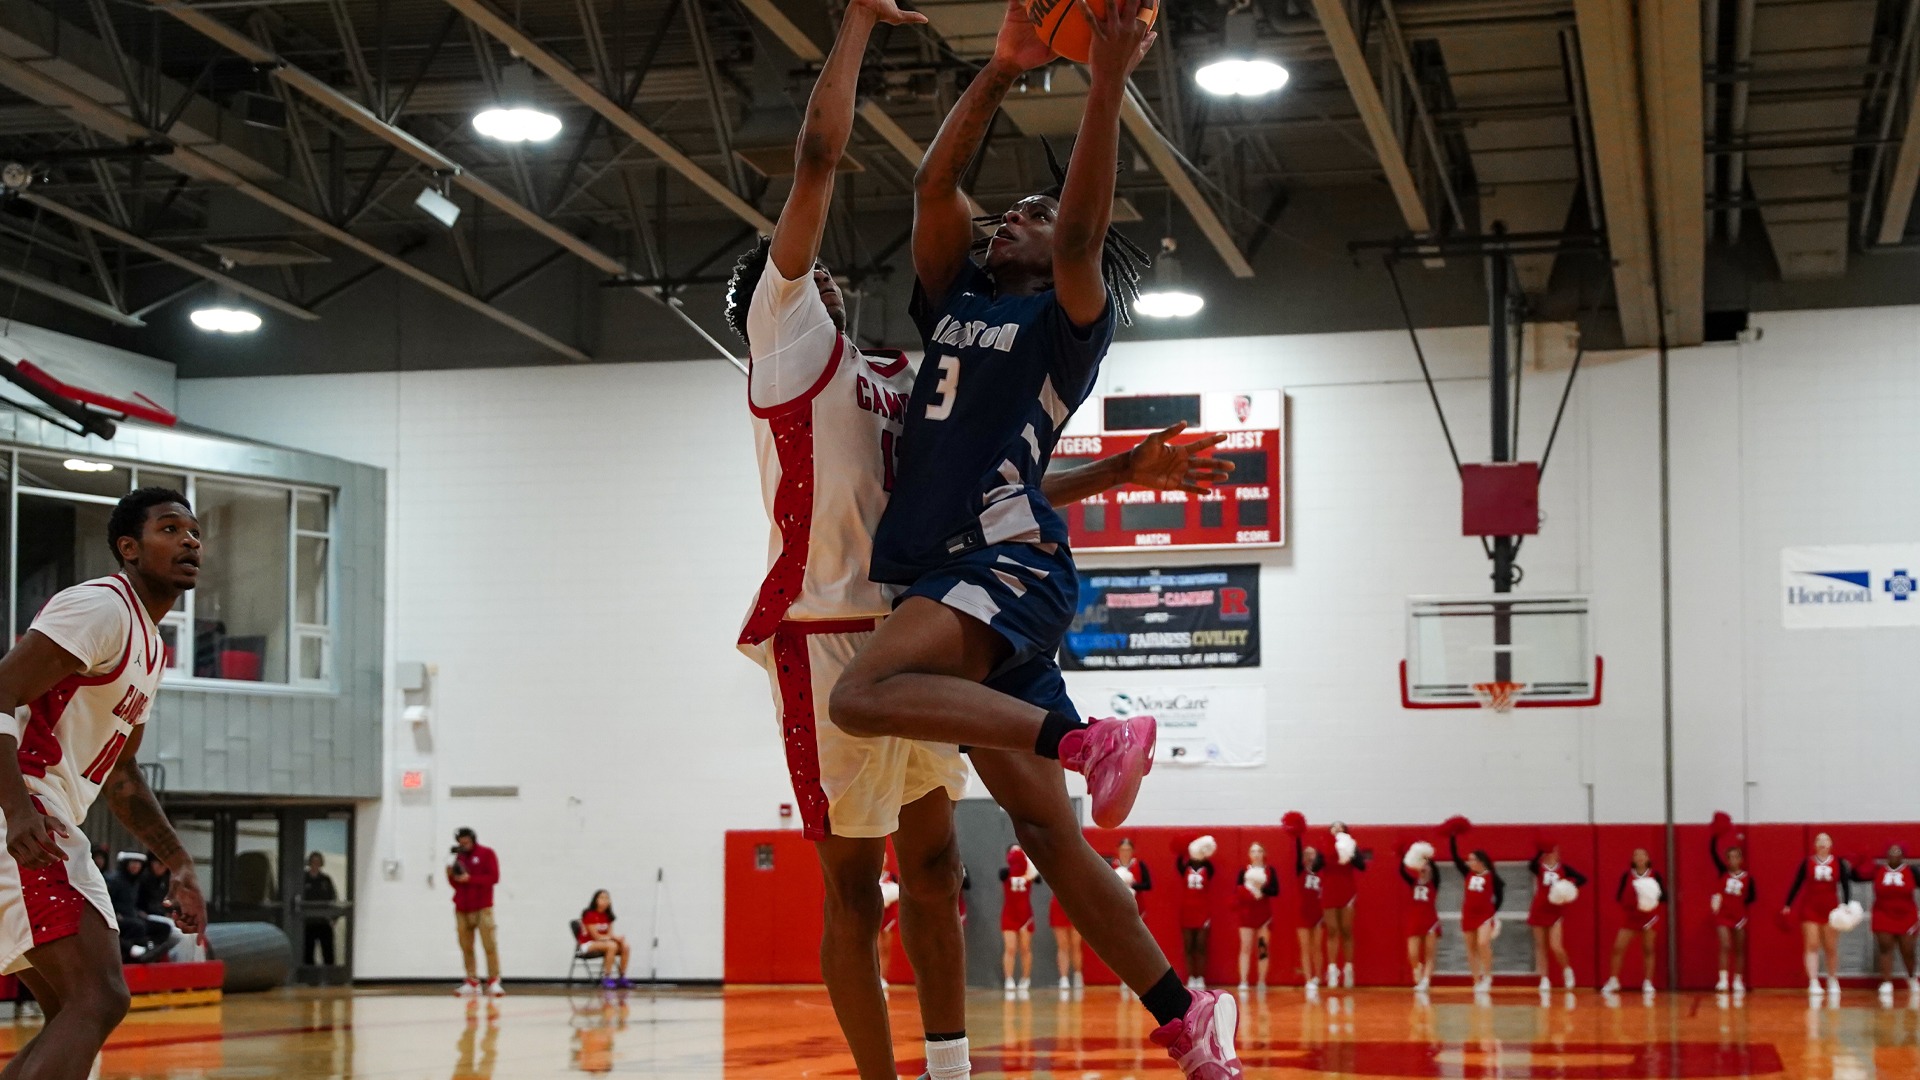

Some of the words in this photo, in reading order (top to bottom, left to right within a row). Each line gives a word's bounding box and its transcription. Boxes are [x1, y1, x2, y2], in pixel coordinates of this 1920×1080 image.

[924, 355, 961, 421] 3
[1053, 437, 1102, 455] TGERS
[1116, 490, 1155, 504] PLAYER
[1235, 486, 1269, 500] FOULS
[1135, 533, 1171, 545] MATCH
[1236, 530, 1270, 542] SCORE
[1219, 588, 1249, 615] R
[1788, 586, 1872, 604] Horizon
[1129, 632, 1191, 649] FAIRNESS
[1193, 630, 1249, 646] CIVILITY
[1137, 695, 1207, 710] NovaCare
[81, 730, 127, 785] 10
[1187, 873, 1203, 889] R
[1815, 865, 1833, 881] R
[1882, 872, 1905, 886] R
[1010, 876, 1027, 892] R
[1305, 874, 1321, 889] R
[1468, 875, 1486, 892] R
[1413, 886, 1429, 901] R
